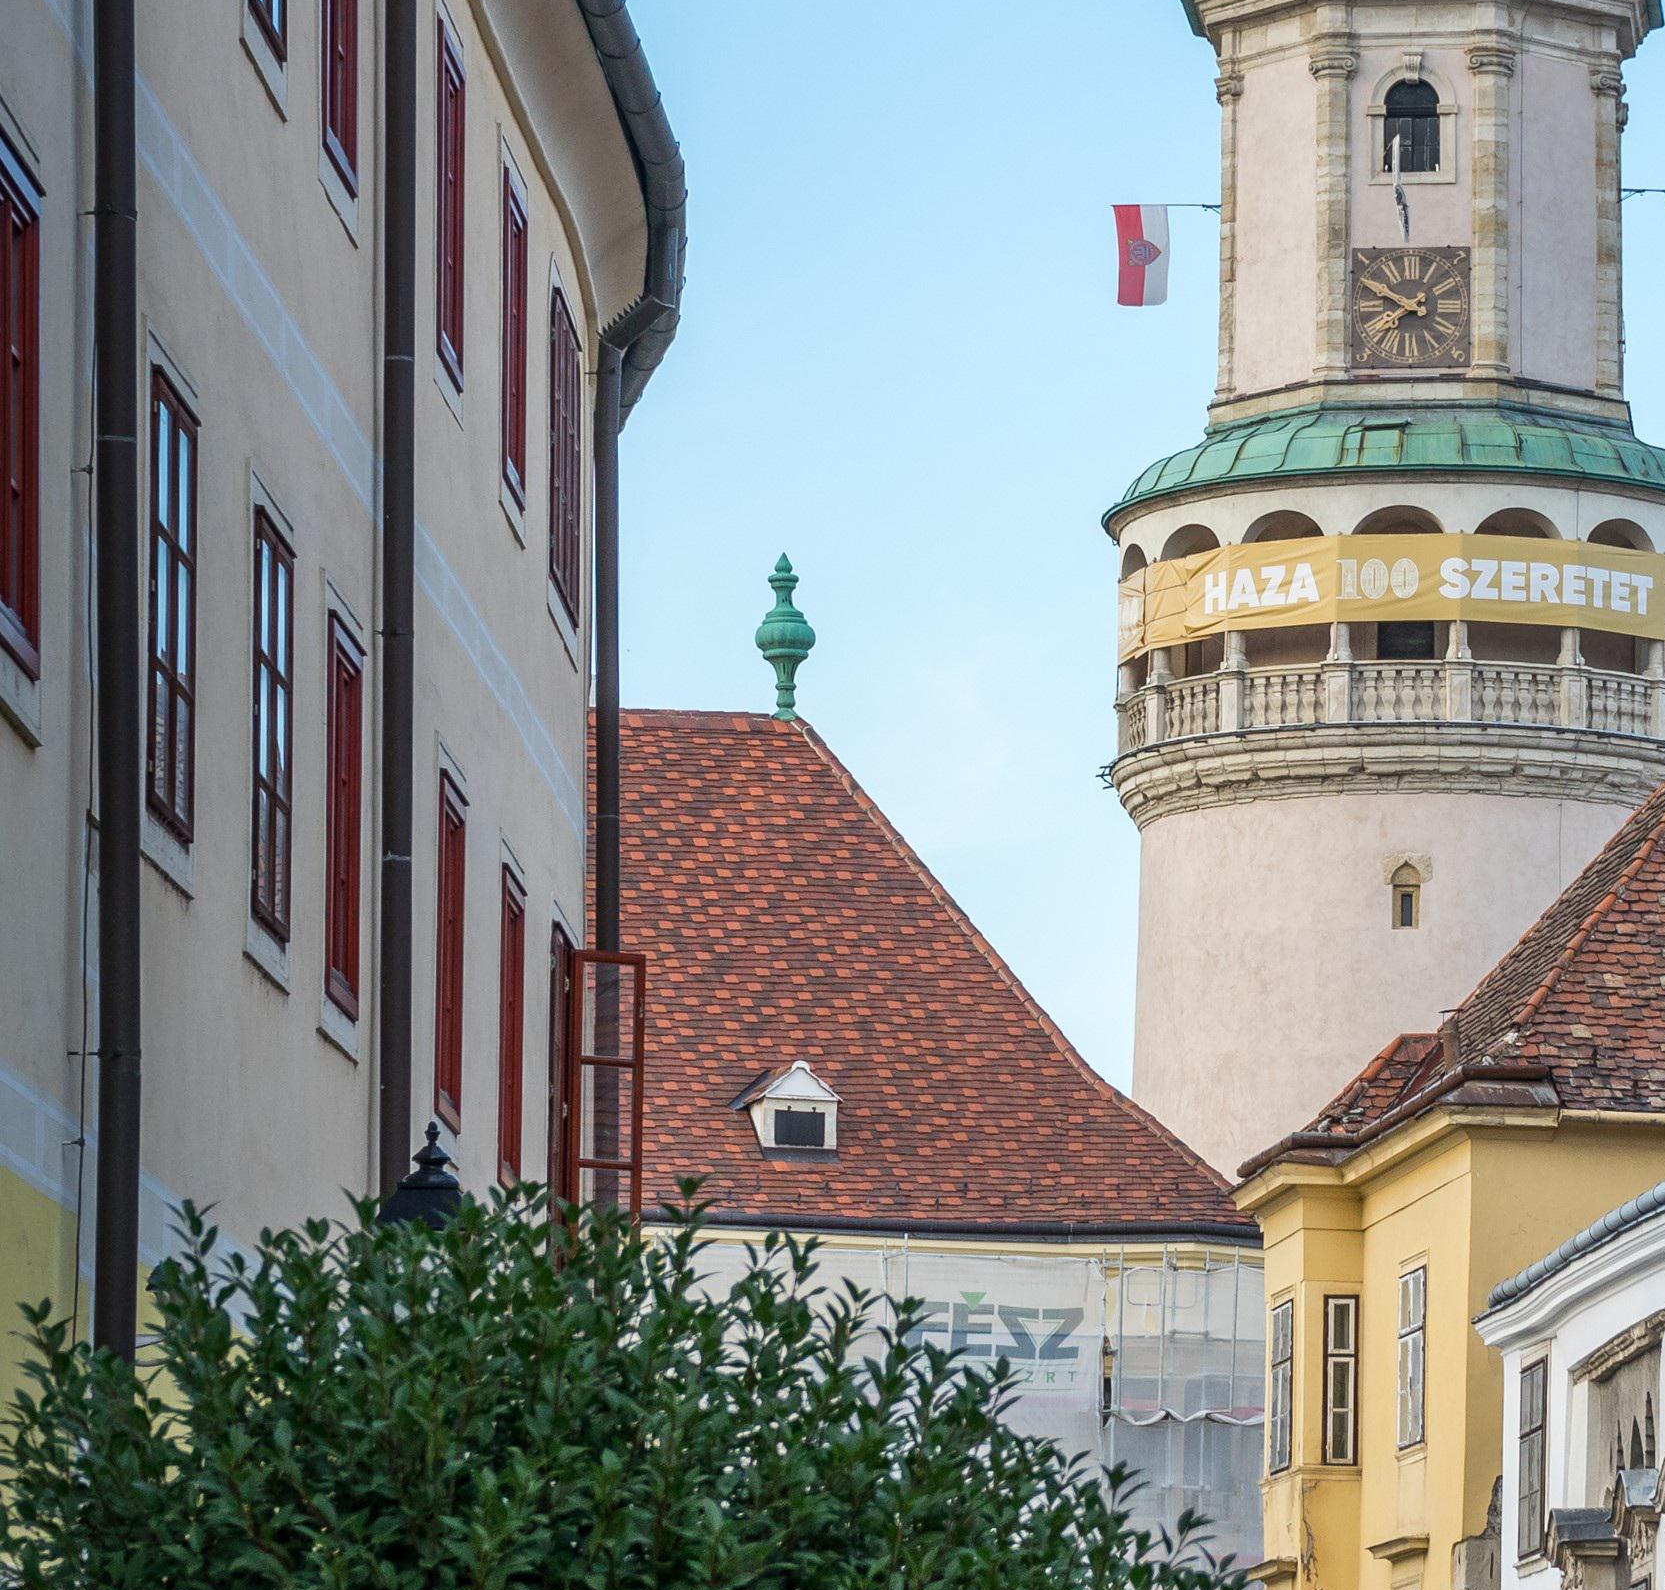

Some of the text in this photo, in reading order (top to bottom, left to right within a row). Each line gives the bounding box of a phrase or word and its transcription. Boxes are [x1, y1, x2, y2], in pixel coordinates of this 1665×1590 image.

[1404, 256, 1420, 280] XII
[1204, 562, 1320, 614] HAZA
[1335, 557, 1420, 600] 100
[1438, 557, 1654, 616] SZERETET
